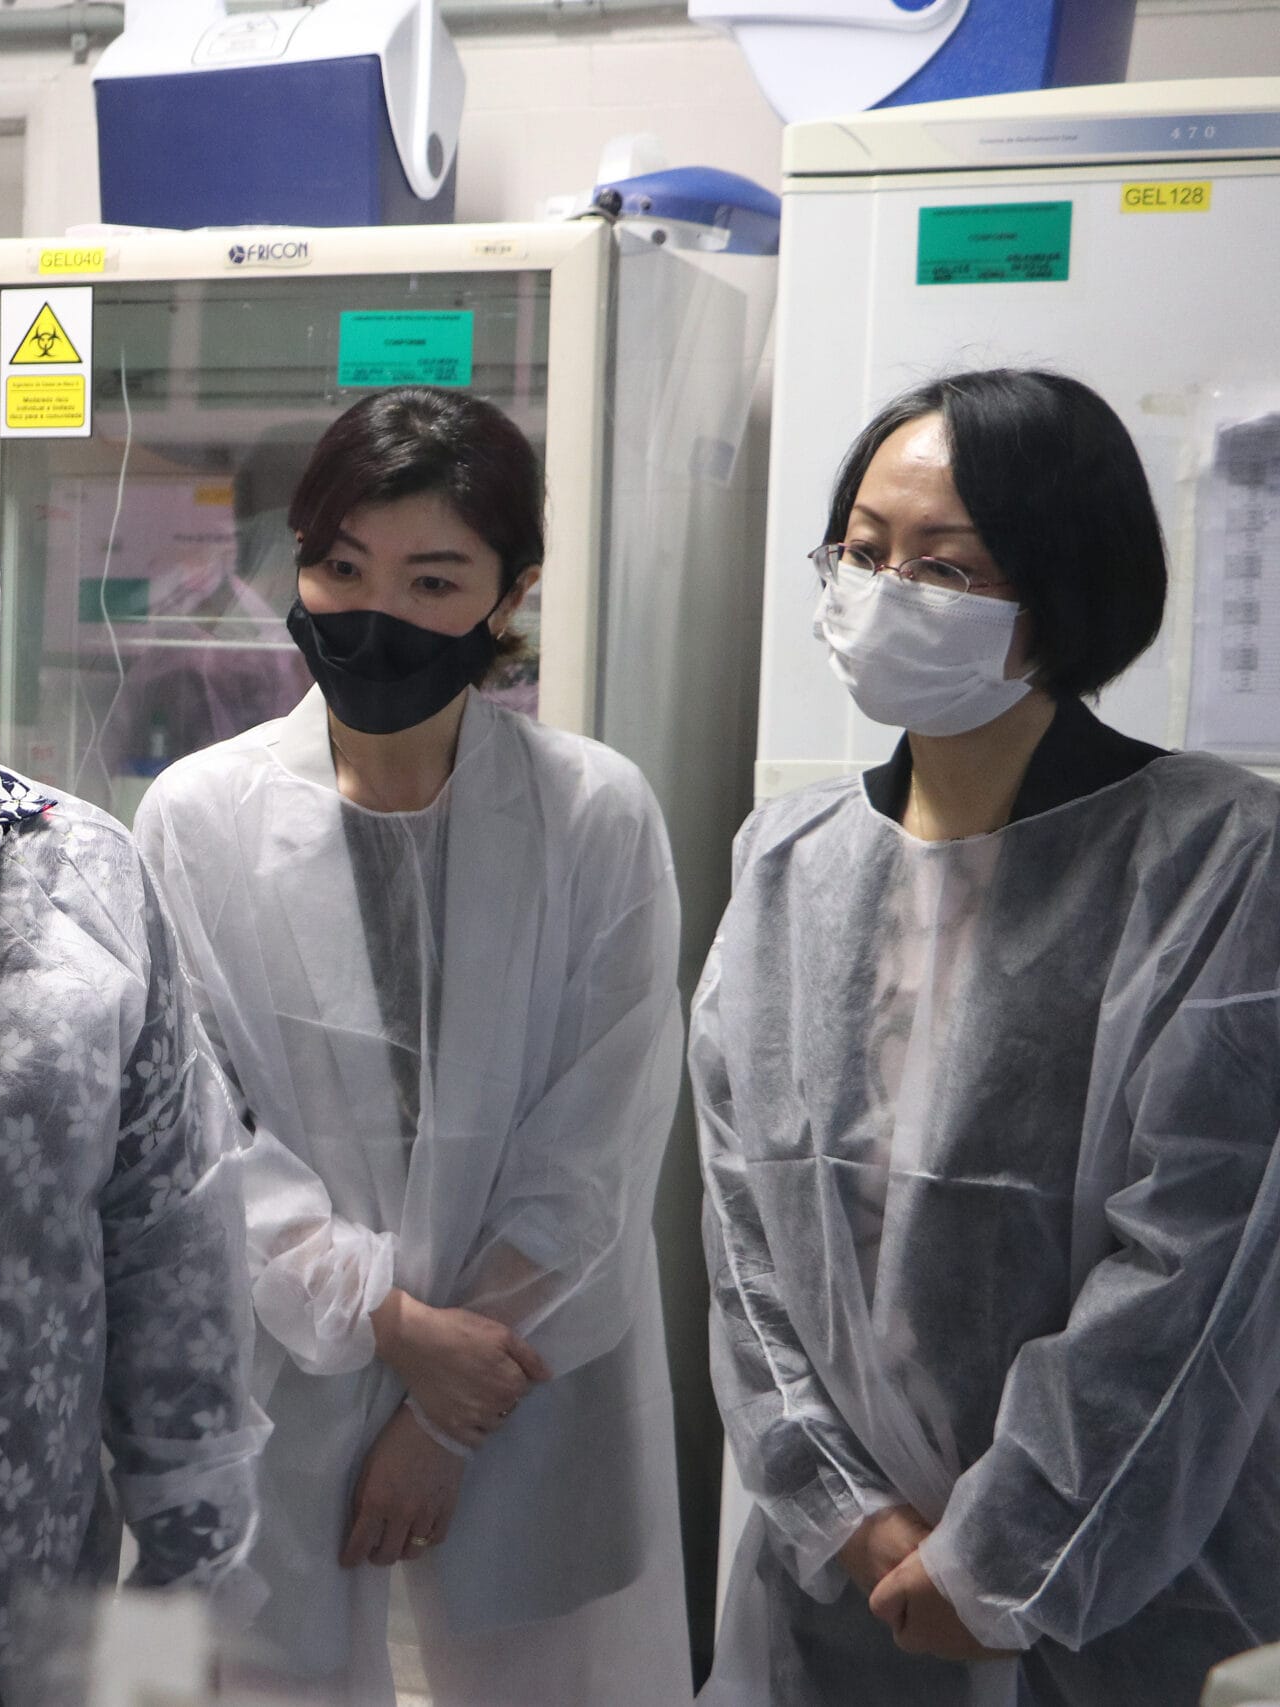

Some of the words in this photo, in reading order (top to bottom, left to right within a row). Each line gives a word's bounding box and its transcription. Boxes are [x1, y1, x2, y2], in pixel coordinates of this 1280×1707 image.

[1170, 126, 1216, 140] 470
[40, 251, 102, 268] GEL040
[247, 242, 308, 260] FRICON
